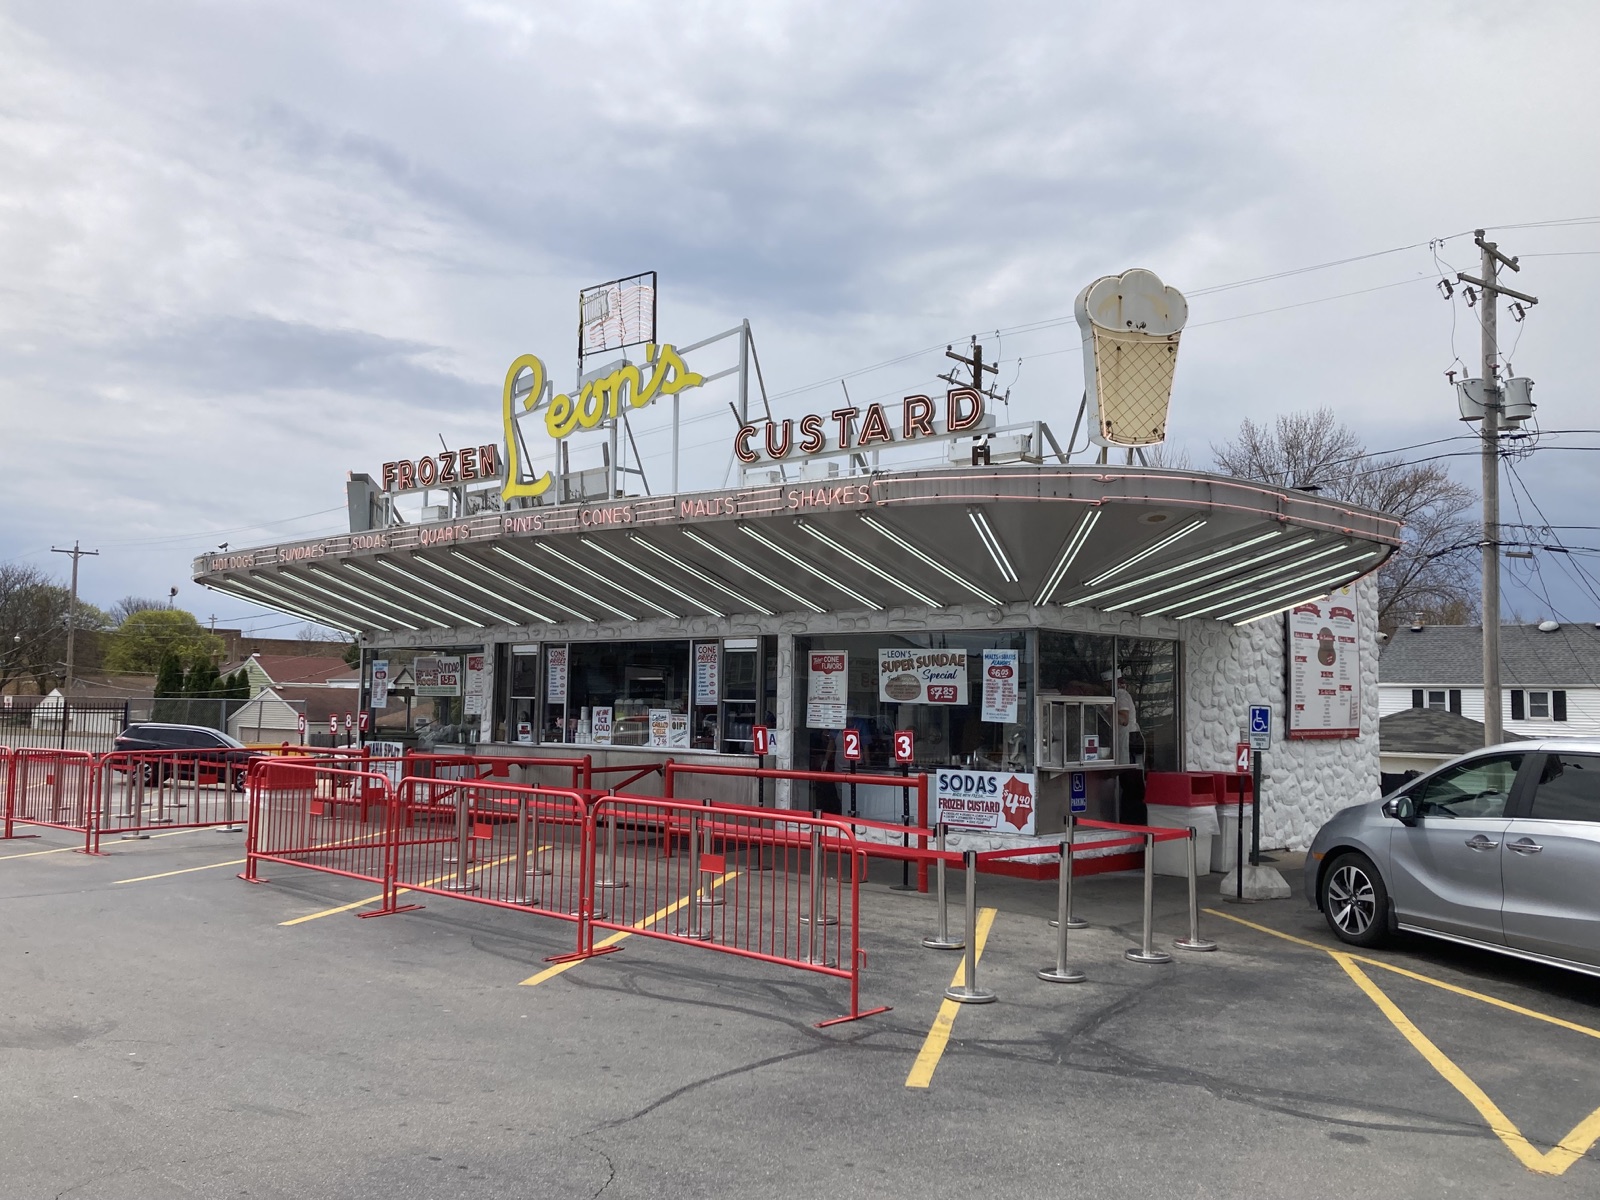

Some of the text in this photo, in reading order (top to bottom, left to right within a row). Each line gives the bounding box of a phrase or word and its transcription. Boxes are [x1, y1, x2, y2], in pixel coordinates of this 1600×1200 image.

[501, 343, 706, 503] Leon's
[734, 386, 985, 464] CUSTARD
[382, 443, 503, 492] FROZEN
[788, 484, 869, 509] SHAKES
[582, 505, 631, 526] CONES
[681, 497, 734, 517] MALTS
[504, 515, 542, 533] PINTS
[420, 525, 469, 544] QUARTS
[351, 535, 388, 552] SODAS
[279, 544, 326, 563] SUNDAES
[212, 554, 254, 571] HOT DOGS
[551, 650, 566, 658] CONE
[698, 646, 716, 654] CONE
[887, 650, 912, 658] LEON'S
[821, 662, 843, 670] FLAVORS
[881, 658, 915, 676] SUPER
[916, 653, 965, 672] SUNDAE
[922, 669, 958, 682] Special
[299, 716, 304, 731] 6
[331, 717, 337, 732] 5
[346, 714, 352, 727] 8
[360, 714, 368, 727] 7
[594, 724, 610, 732] COLD
[672, 721, 687, 730] GIFT
[756, 730, 763, 750] 1
[768, 734, 776, 745] A
[846, 734, 858, 755] 2
[897, 736, 911, 757] 3
[1238, 748, 1248, 770] 4
[939, 773, 998, 795] SODAS
[938, 797, 1000, 813] FROZEN CUSTARD
